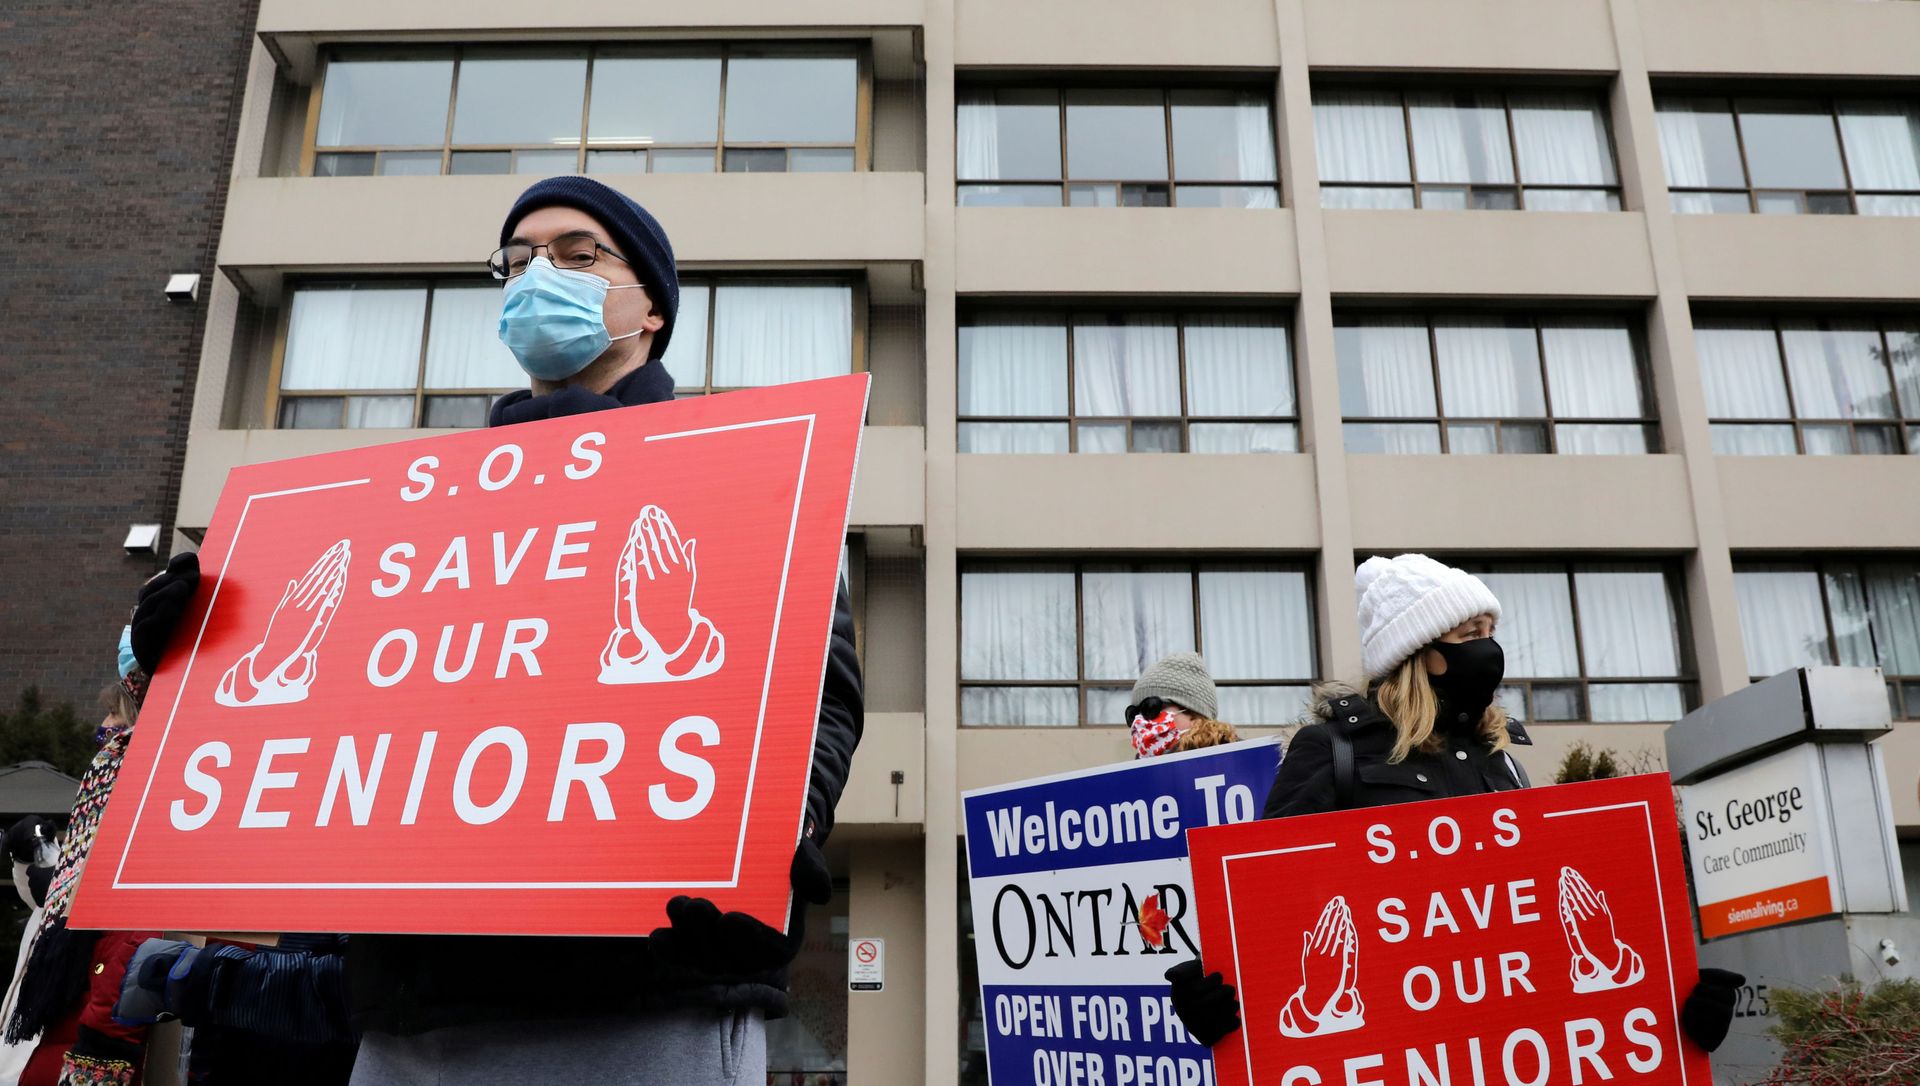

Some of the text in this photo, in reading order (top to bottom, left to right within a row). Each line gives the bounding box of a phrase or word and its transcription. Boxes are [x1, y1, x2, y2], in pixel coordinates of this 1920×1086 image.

[400, 431, 606, 503] S.O.S
[371, 520, 597, 598] SAVE
[367, 618, 548, 688] OUR
[170, 716, 721, 832] SENIORS
[986, 773, 1255, 858] Welcome To
[1367, 808, 1521, 864] S.O.S
[1696, 786, 1803, 841] St. George
[1703, 832, 1807, 874] Care Community
[1378, 878, 1541, 943] SAVE
[1728, 898, 1798, 924] siennaliving.ca
[1403, 951, 1537, 1011] OUR
[1735, 985, 1770, 1018] 225
[995, 994, 1202, 1045] OPEN FOR PR
[1034, 1048, 1106, 1086] OVER
